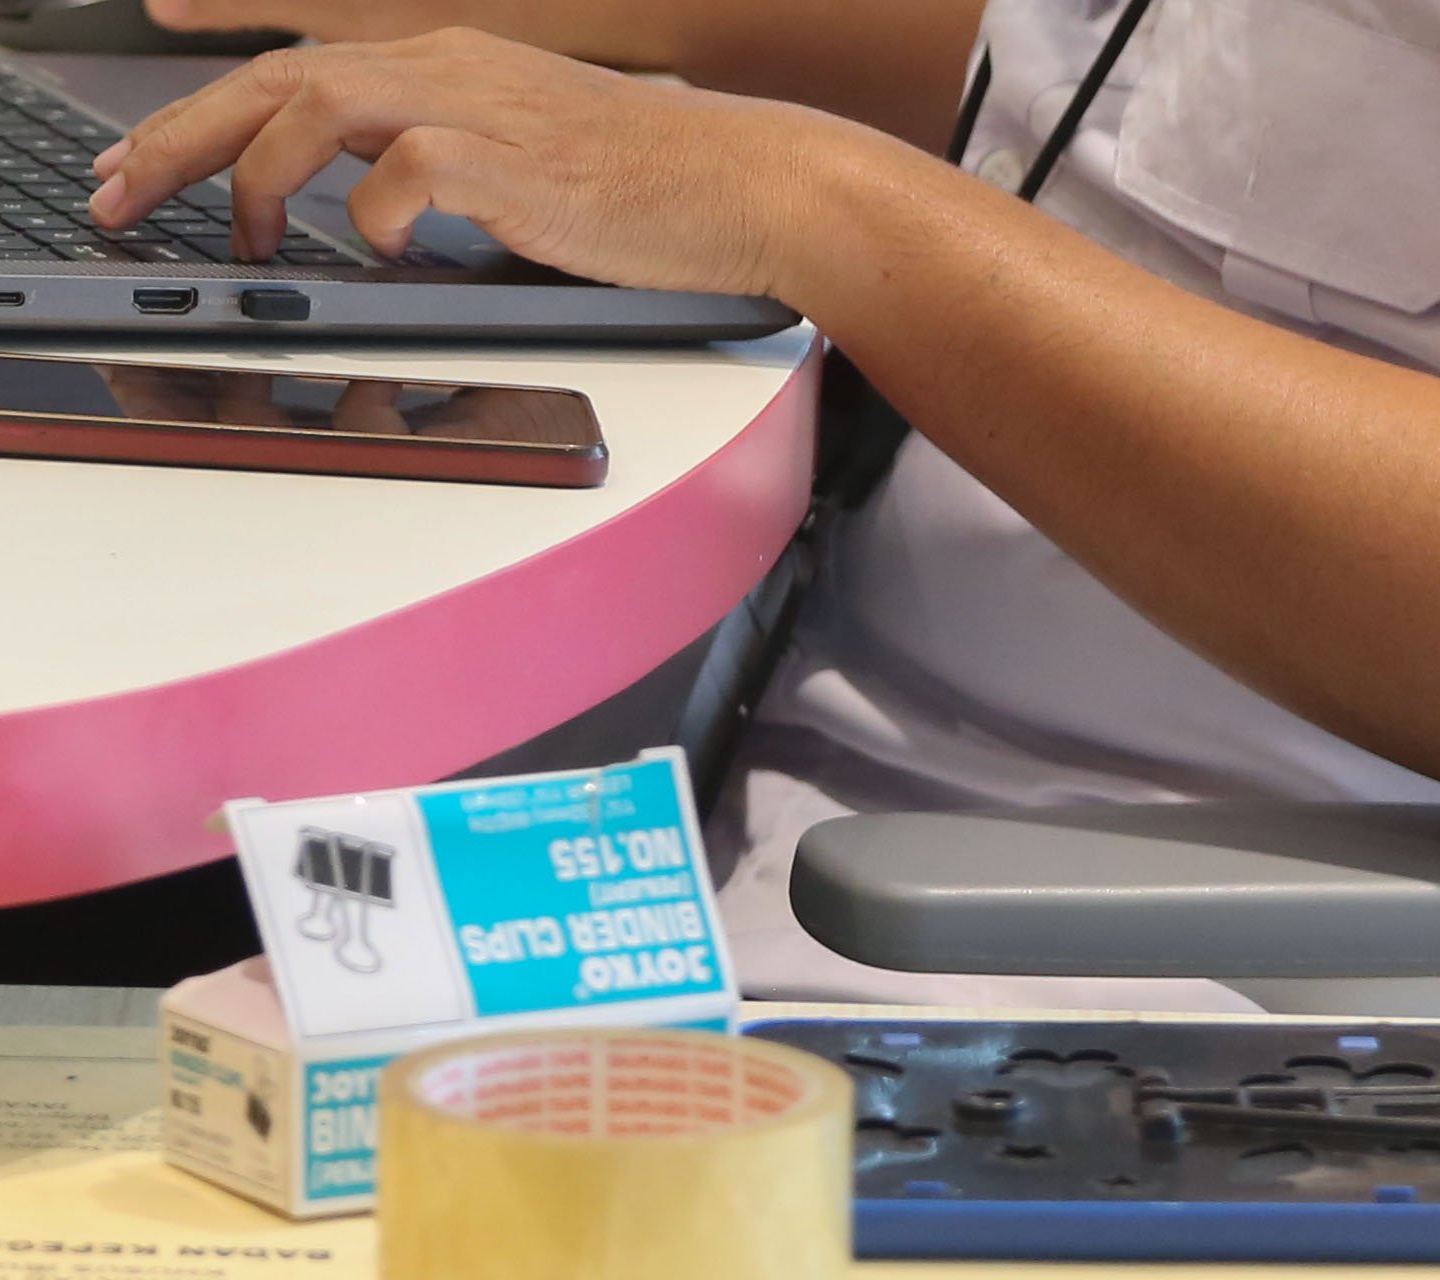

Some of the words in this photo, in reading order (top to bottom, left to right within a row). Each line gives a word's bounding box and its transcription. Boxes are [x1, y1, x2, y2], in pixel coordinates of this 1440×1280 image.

[548, 826, 686, 882] NO.155
[459, 915, 566, 966] CLIPS
[567, 901, 706, 953] BINDER
[578, 945, 712, 992] JOYKO
[175, 1243, 331, 1261] BADAN
